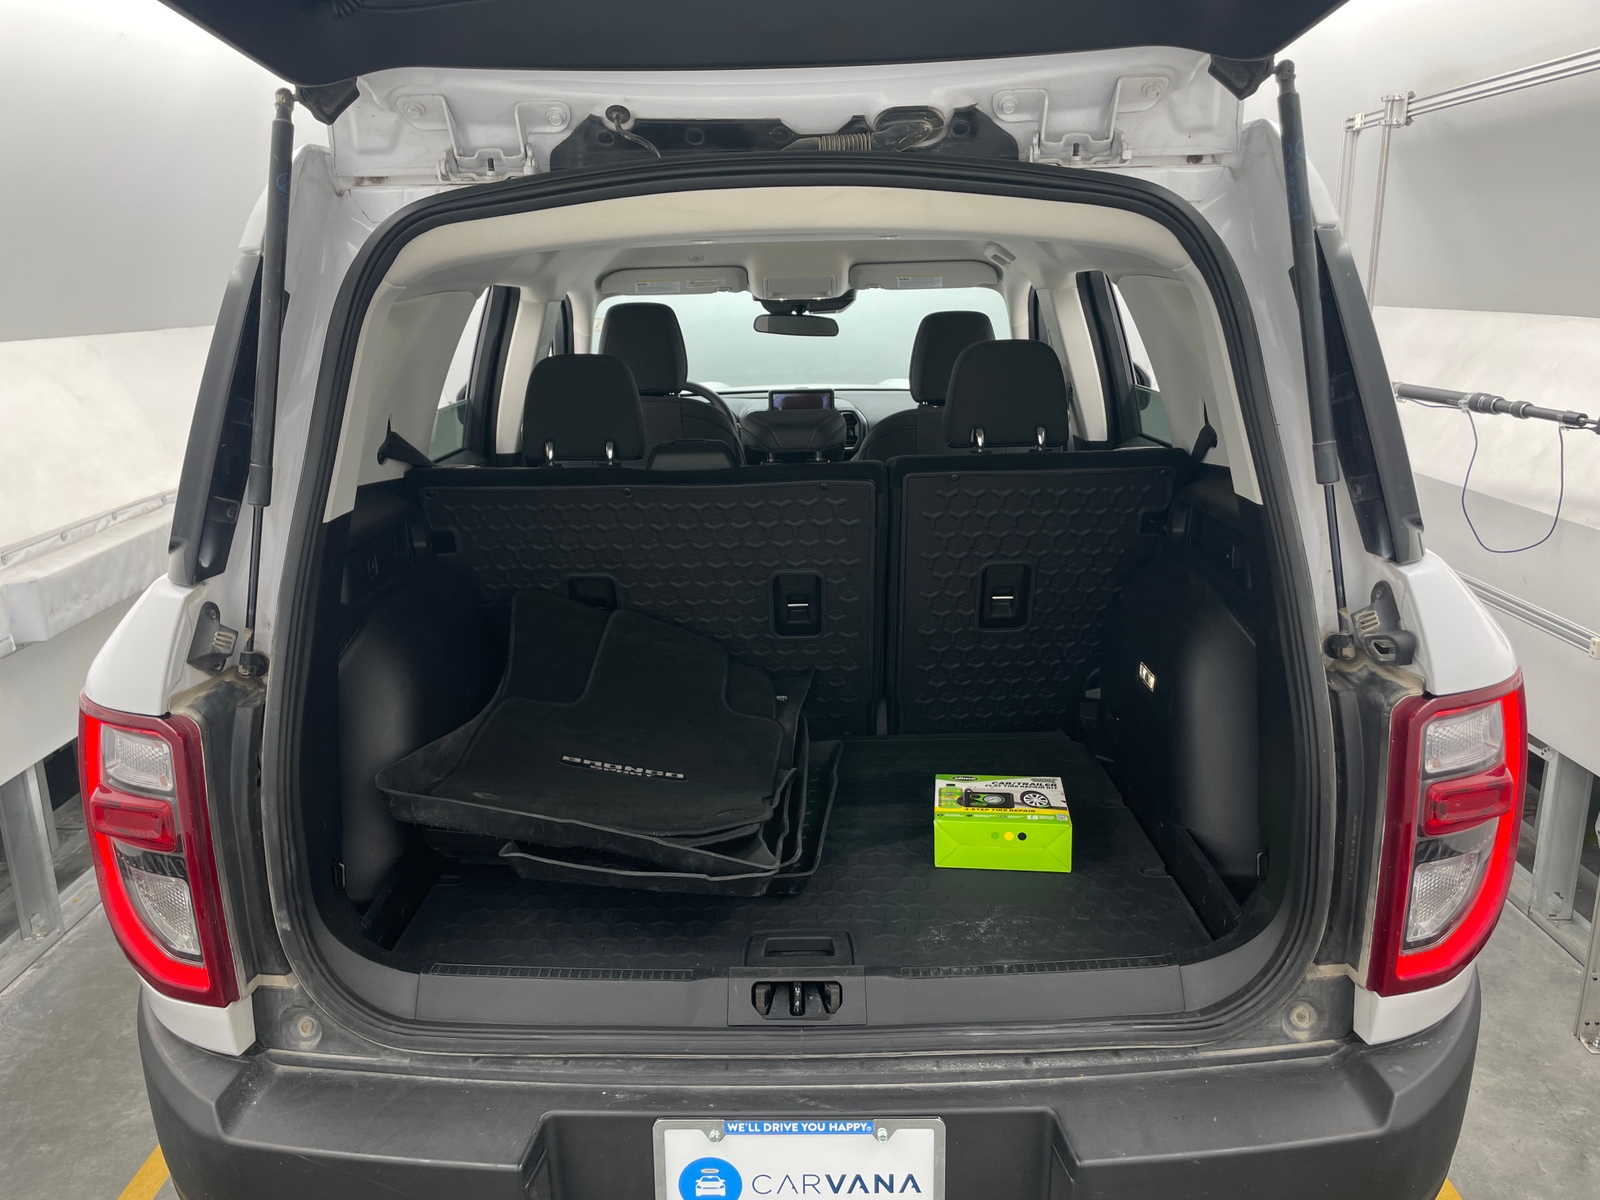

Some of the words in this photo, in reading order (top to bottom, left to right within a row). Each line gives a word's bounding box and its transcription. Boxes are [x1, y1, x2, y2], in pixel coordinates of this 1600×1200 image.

[562, 755, 684, 779] BRONCO
[727, 1122, 761, 1133] WE'LL
[764, 1122, 799, 1133] DRIVE
[800, 1122, 825, 1132] YOU
[751, 1173, 922, 1195] CARVANA
